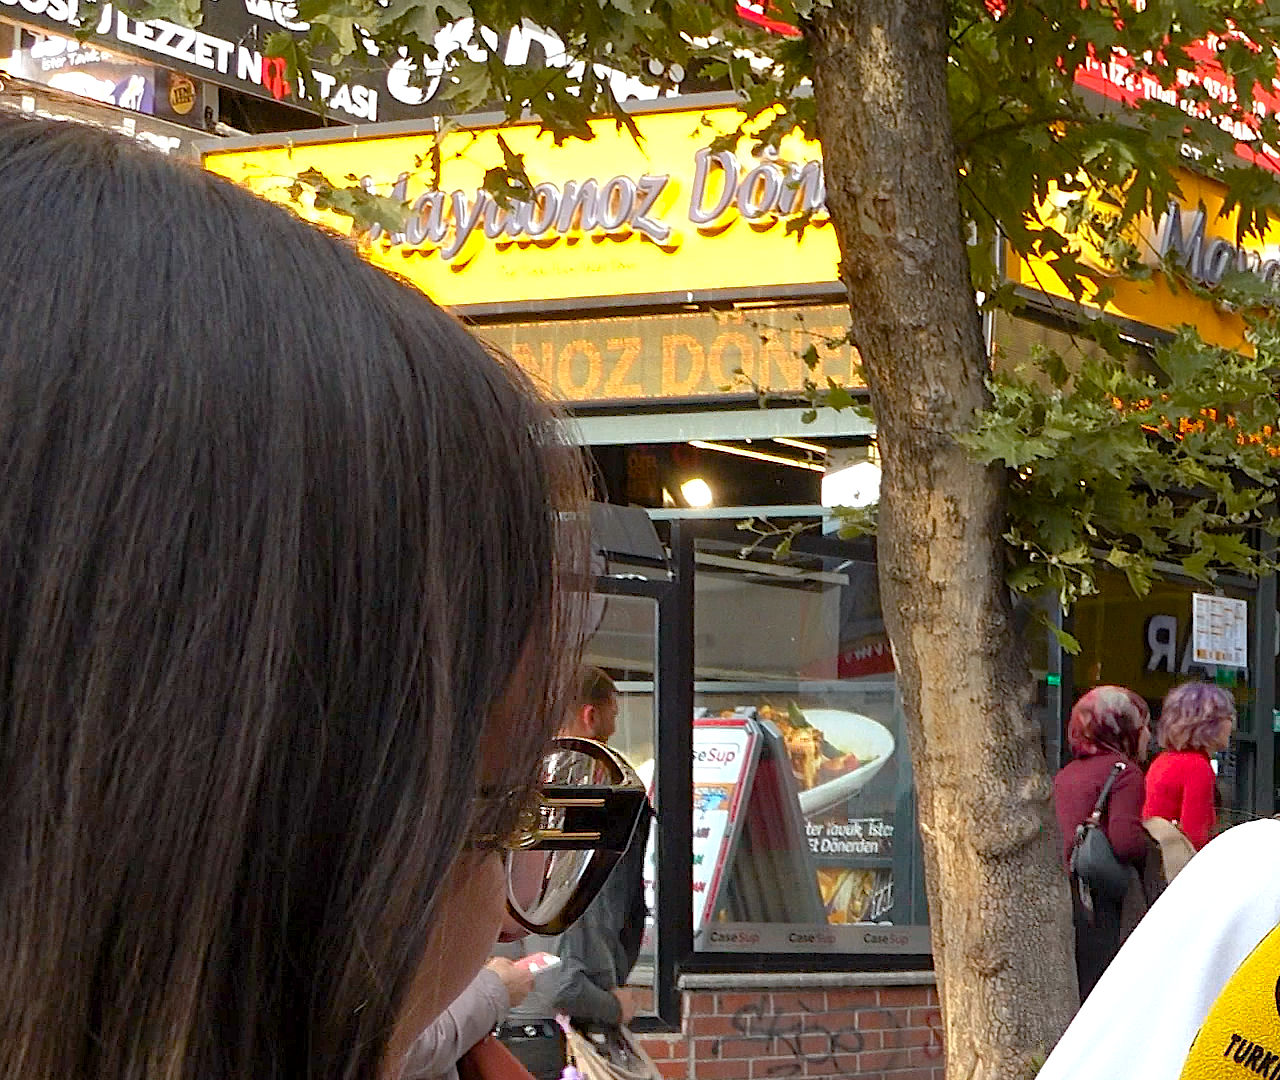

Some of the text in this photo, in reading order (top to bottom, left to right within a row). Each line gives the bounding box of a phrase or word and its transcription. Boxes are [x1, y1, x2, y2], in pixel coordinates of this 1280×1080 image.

[117, 10, 234, 73] LEZZET
[689, 143, 827, 225] Dön
[661, 310, 866, 397] DÖNE
